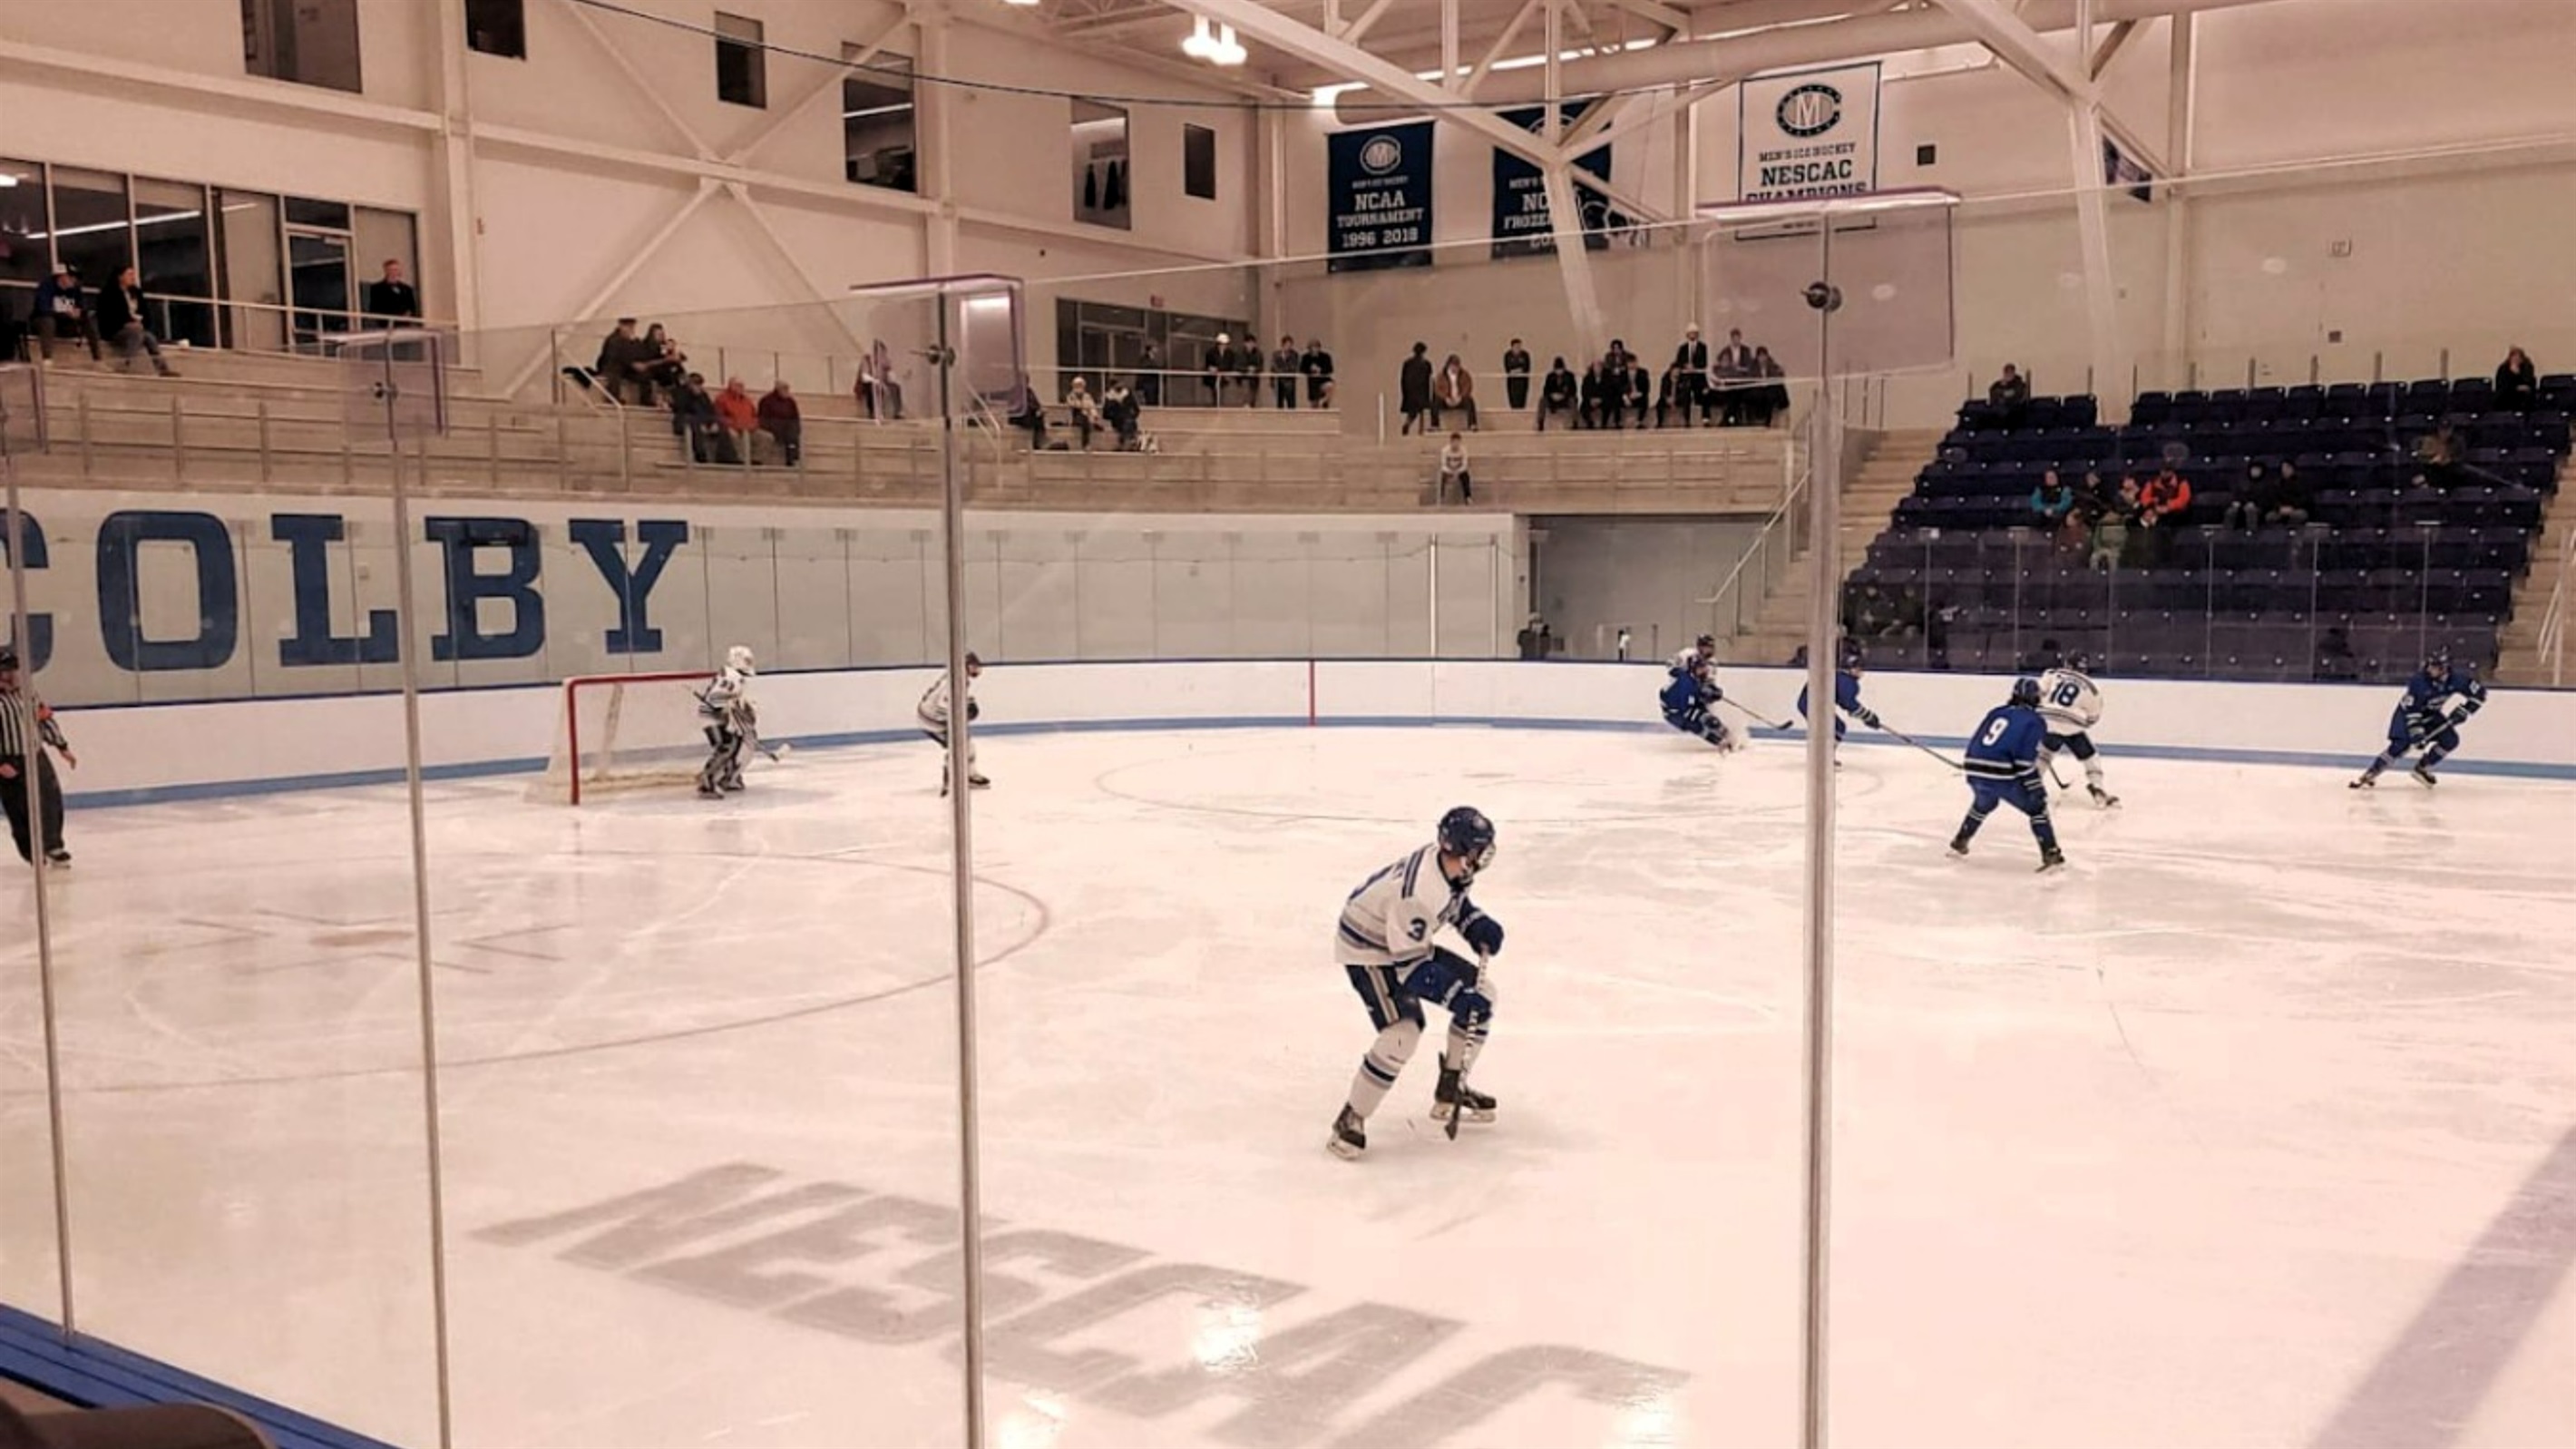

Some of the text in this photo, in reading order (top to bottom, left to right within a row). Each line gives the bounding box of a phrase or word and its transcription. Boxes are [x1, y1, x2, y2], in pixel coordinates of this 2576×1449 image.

[1761, 160, 1850, 185] NESCAC
[1354, 190, 1404, 210] NCAA
[1336, 208, 1423, 227] TOURNAMENT
[2049, 680, 2079, 707] 18
[1982, 718, 2007, 745] 9
[1407, 917, 1426, 941] 3
